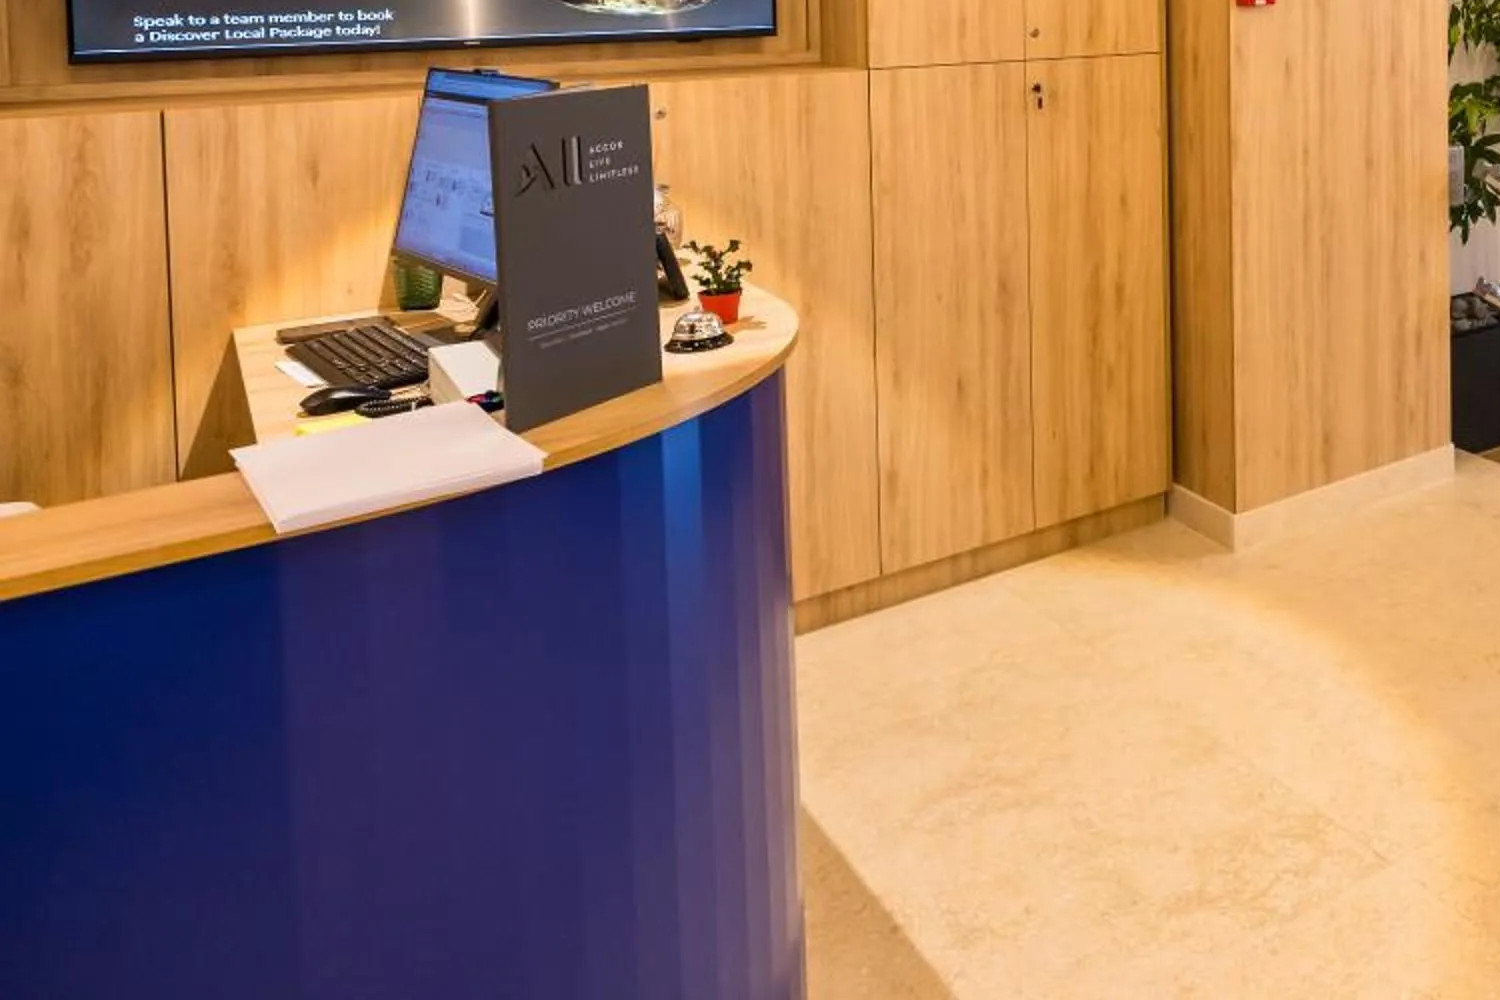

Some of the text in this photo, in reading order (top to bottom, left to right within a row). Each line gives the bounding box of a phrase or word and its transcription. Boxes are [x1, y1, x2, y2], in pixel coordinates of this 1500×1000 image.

[133, 8, 395, 30] Speak to a team member to book
[135, 25, 381, 43] a Discover Local Package today!
[527, 290, 637, 331] PRIORITY WELCOME
